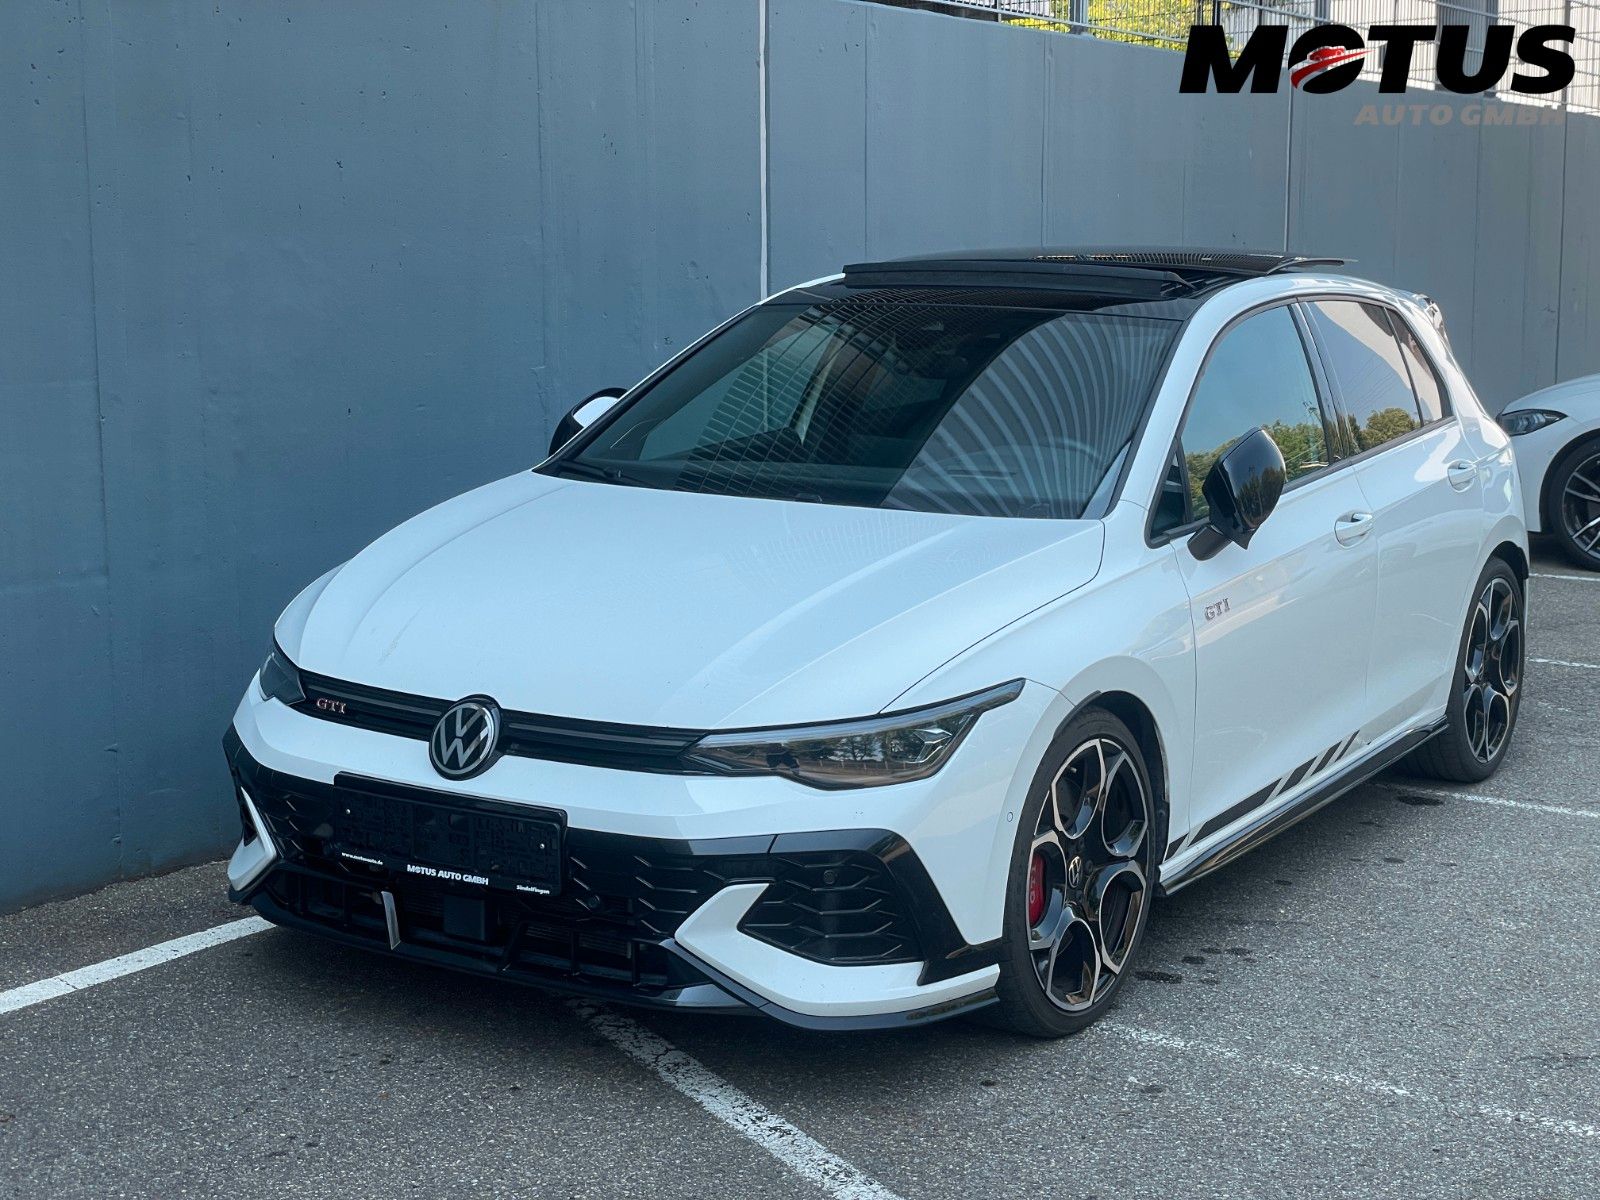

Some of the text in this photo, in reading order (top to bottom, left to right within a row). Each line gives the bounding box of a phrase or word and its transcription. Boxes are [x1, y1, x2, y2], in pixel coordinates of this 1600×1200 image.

[1204, 597, 1231, 621] GTI
[316, 697, 347, 714] GTI
[406, 863, 489, 886] MOTUS AUTO GMBH
